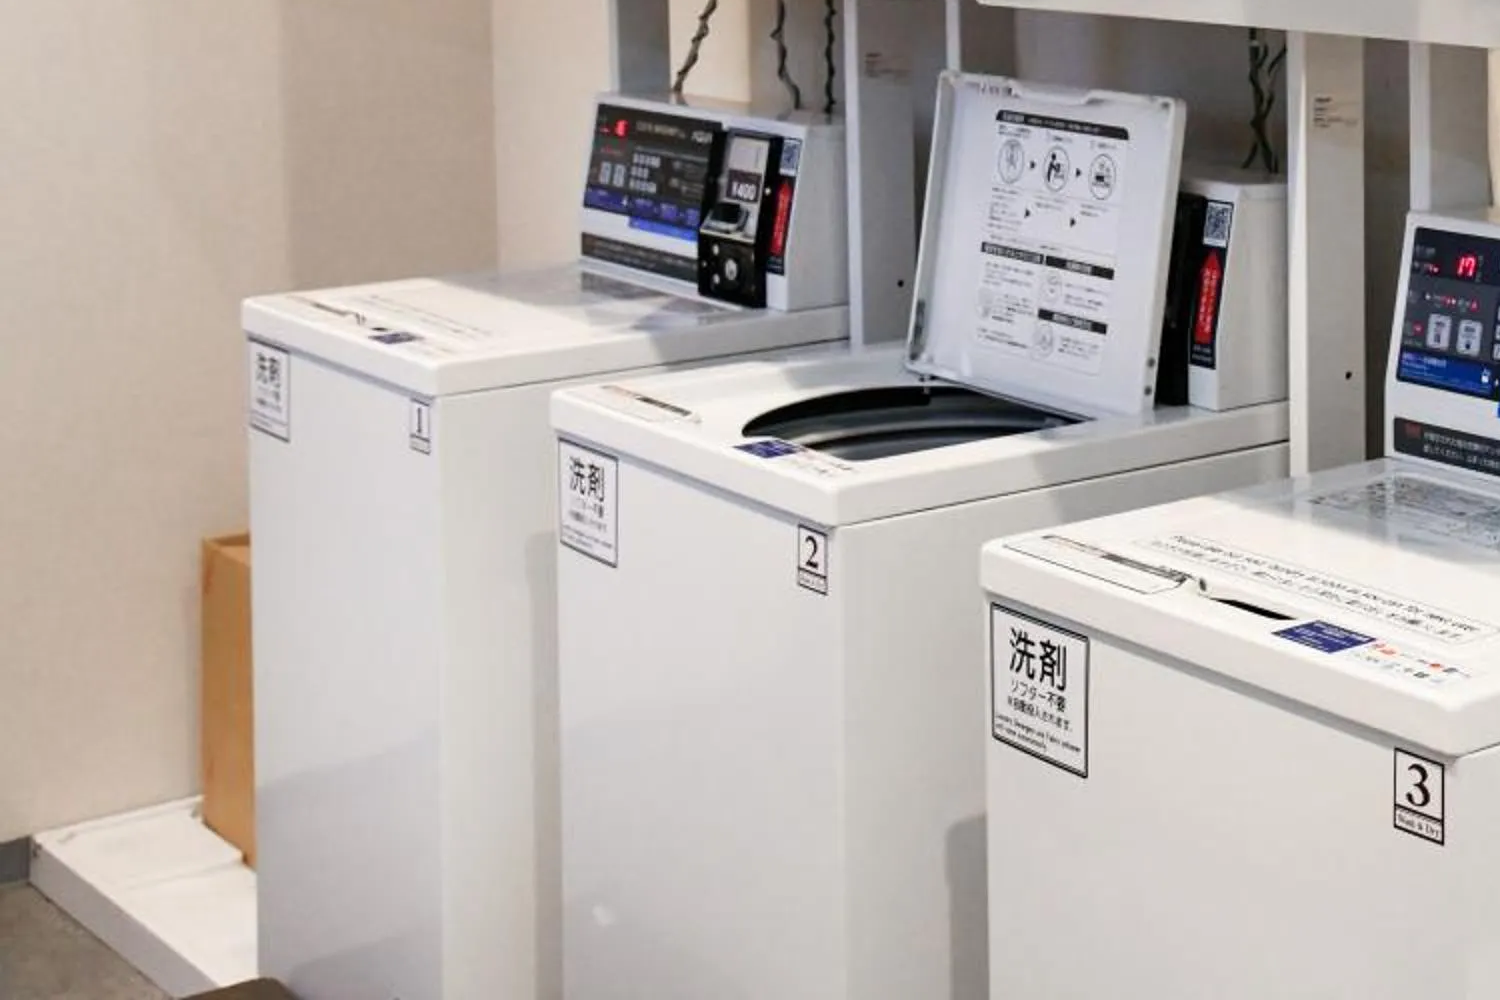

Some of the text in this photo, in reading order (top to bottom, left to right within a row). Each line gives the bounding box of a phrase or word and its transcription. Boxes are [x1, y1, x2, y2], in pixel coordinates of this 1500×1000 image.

[569, 455, 604, 502] 洗剤
[805, 536, 818, 569] 2
[1009, 626, 1067, 691] 洗剤
[1406, 763, 1430, 806] 3
